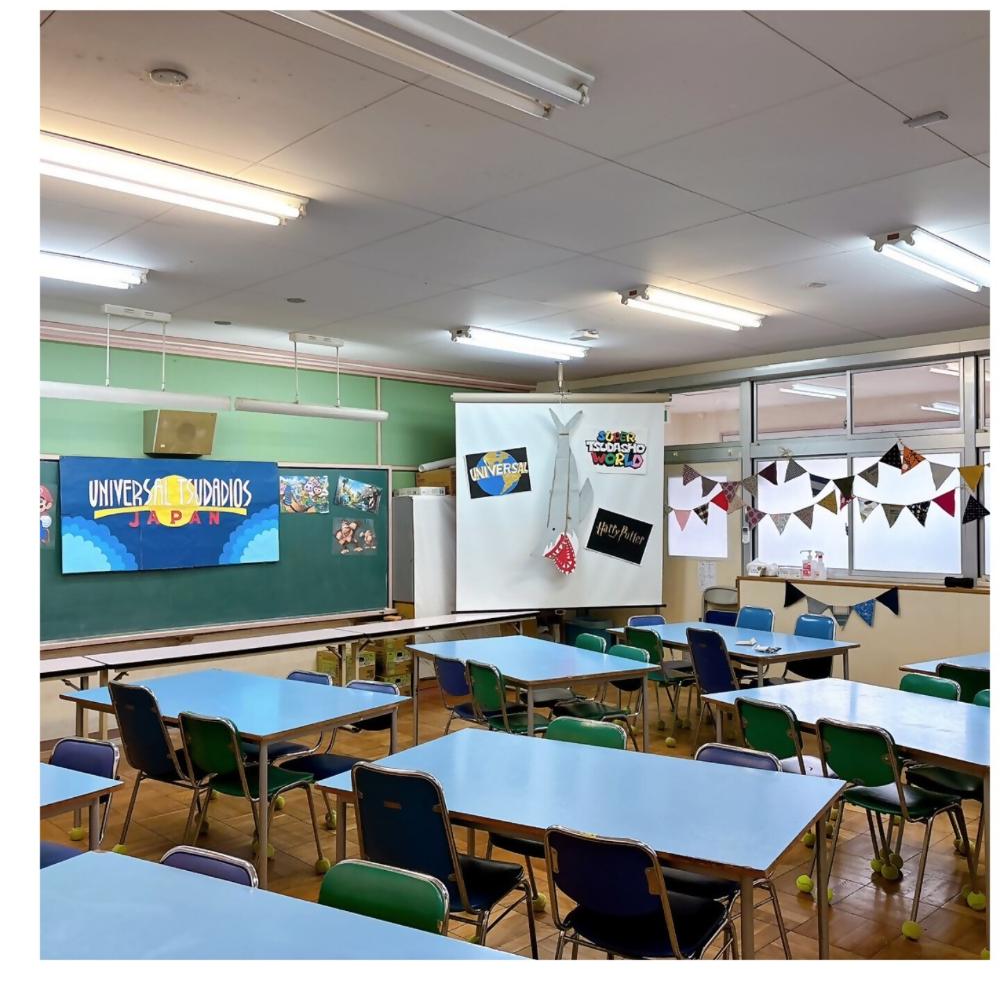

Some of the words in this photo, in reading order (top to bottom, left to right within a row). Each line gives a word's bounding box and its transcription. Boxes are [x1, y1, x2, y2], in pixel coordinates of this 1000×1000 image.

[597, 430, 636, 443] SUPER
[591, 451, 643, 469] WORLD
[469, 461, 529, 482] UNIVERSAL
[89, 476, 168, 507] UNIVERSAL
[179, 478, 251, 508] TSUDADIOS
[128, 510, 220, 528] JAPAN
[596, 521, 620, 539] Harry
[617, 524, 645, 544] Potter
